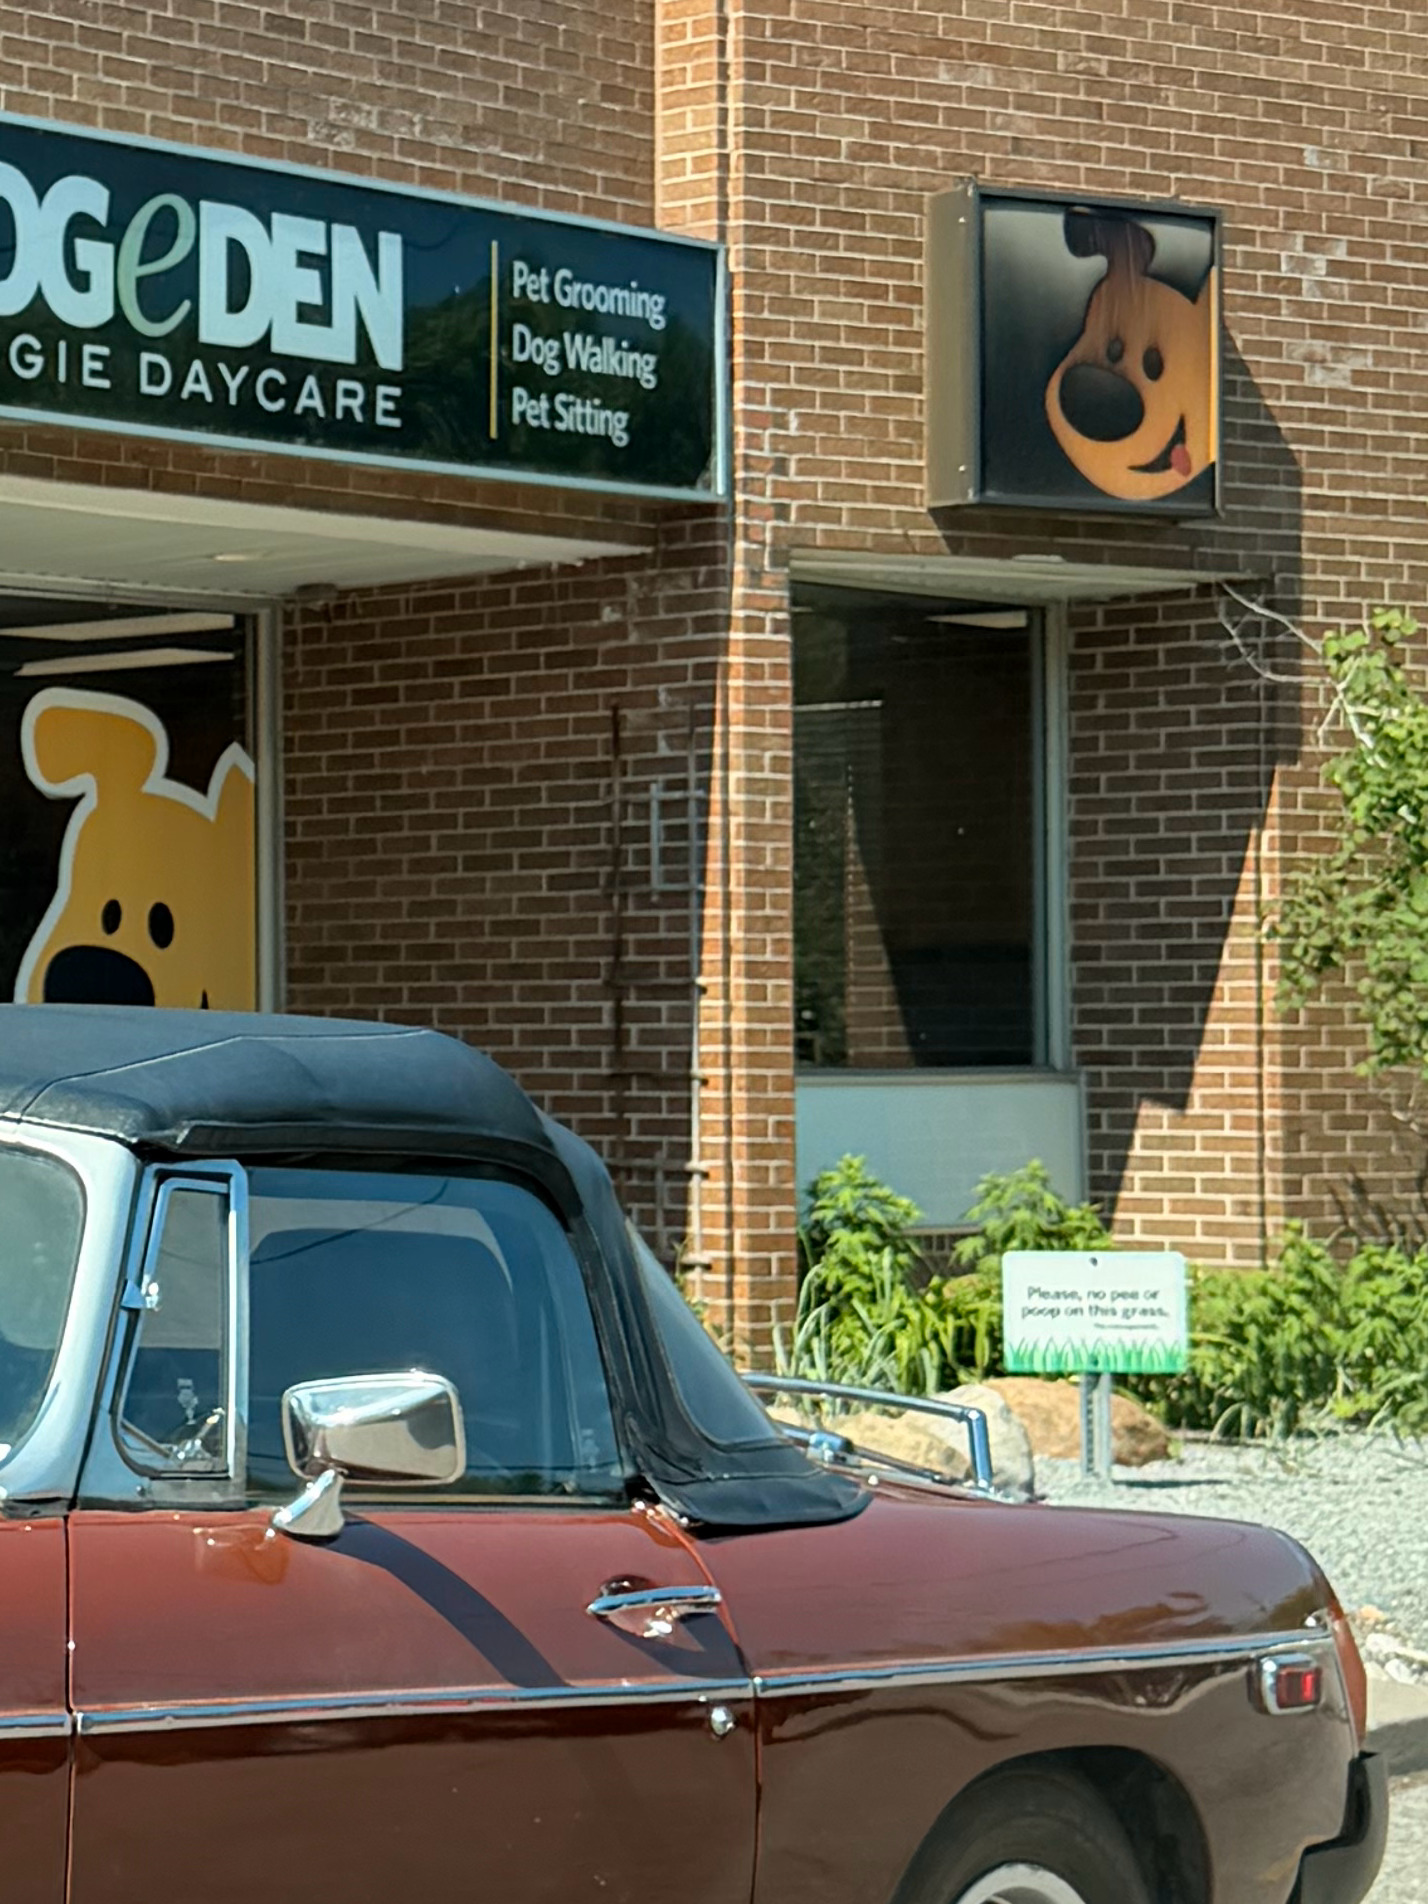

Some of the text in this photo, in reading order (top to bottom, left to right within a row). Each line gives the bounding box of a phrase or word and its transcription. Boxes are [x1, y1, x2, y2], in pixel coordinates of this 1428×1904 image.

[512, 260, 667, 330] Pet Grooming
[512, 325, 658, 390] Dog Walking
[139, 351, 402, 429] DAYCARE
[511, 389, 630, 447] Pet Sitting
[1021, 1305, 1062, 1321] poop
[1064, 1306, 1085, 1318] on
[1088, 1303, 1118, 1318] this
[1027, 1285, 1161, 1304] Please, no pee or
